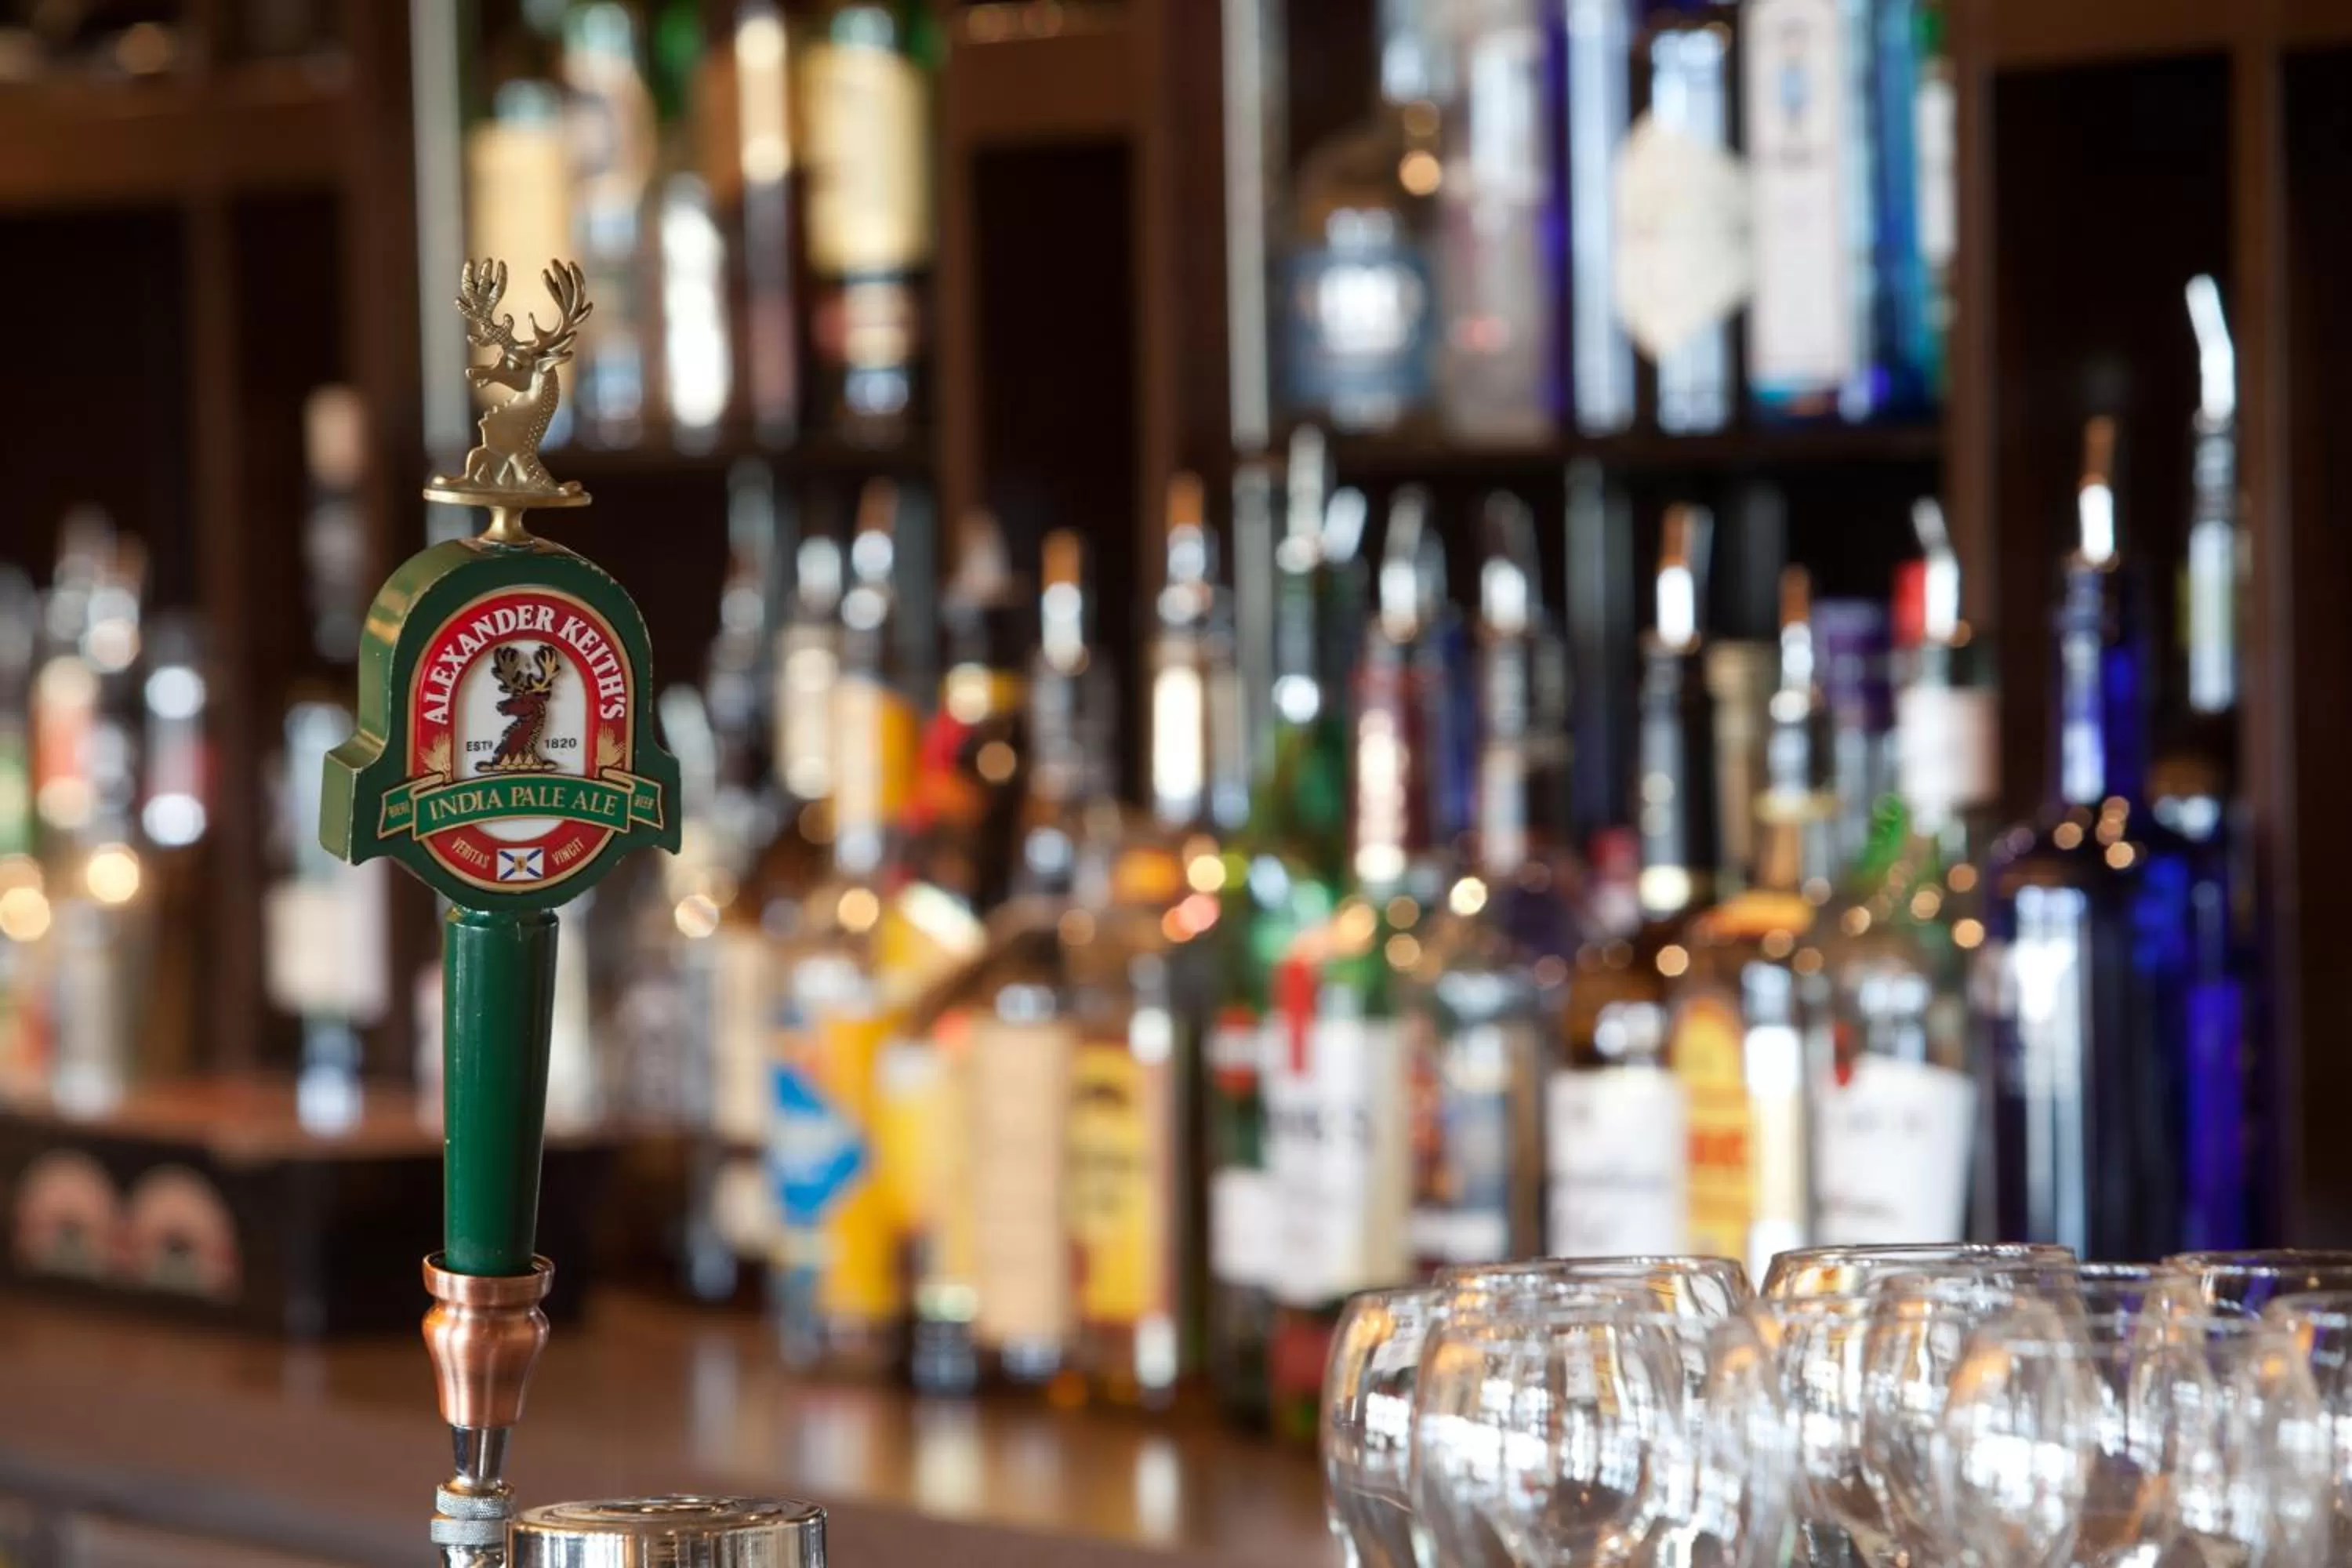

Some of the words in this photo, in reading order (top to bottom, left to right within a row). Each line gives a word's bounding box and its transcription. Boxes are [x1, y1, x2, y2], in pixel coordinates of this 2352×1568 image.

[423, 604, 556, 725] ALEXANDER
[558, 615, 626, 720] KEITH'S
[545, 738, 577, 749] 1820
[429, 788, 503, 821] INDIA
[510, 786, 565, 808] PALE
[571, 789, 618, 816] ALE
[452, 837, 490, 869] VERITAS
[551, 837, 584, 866] VINCIT
